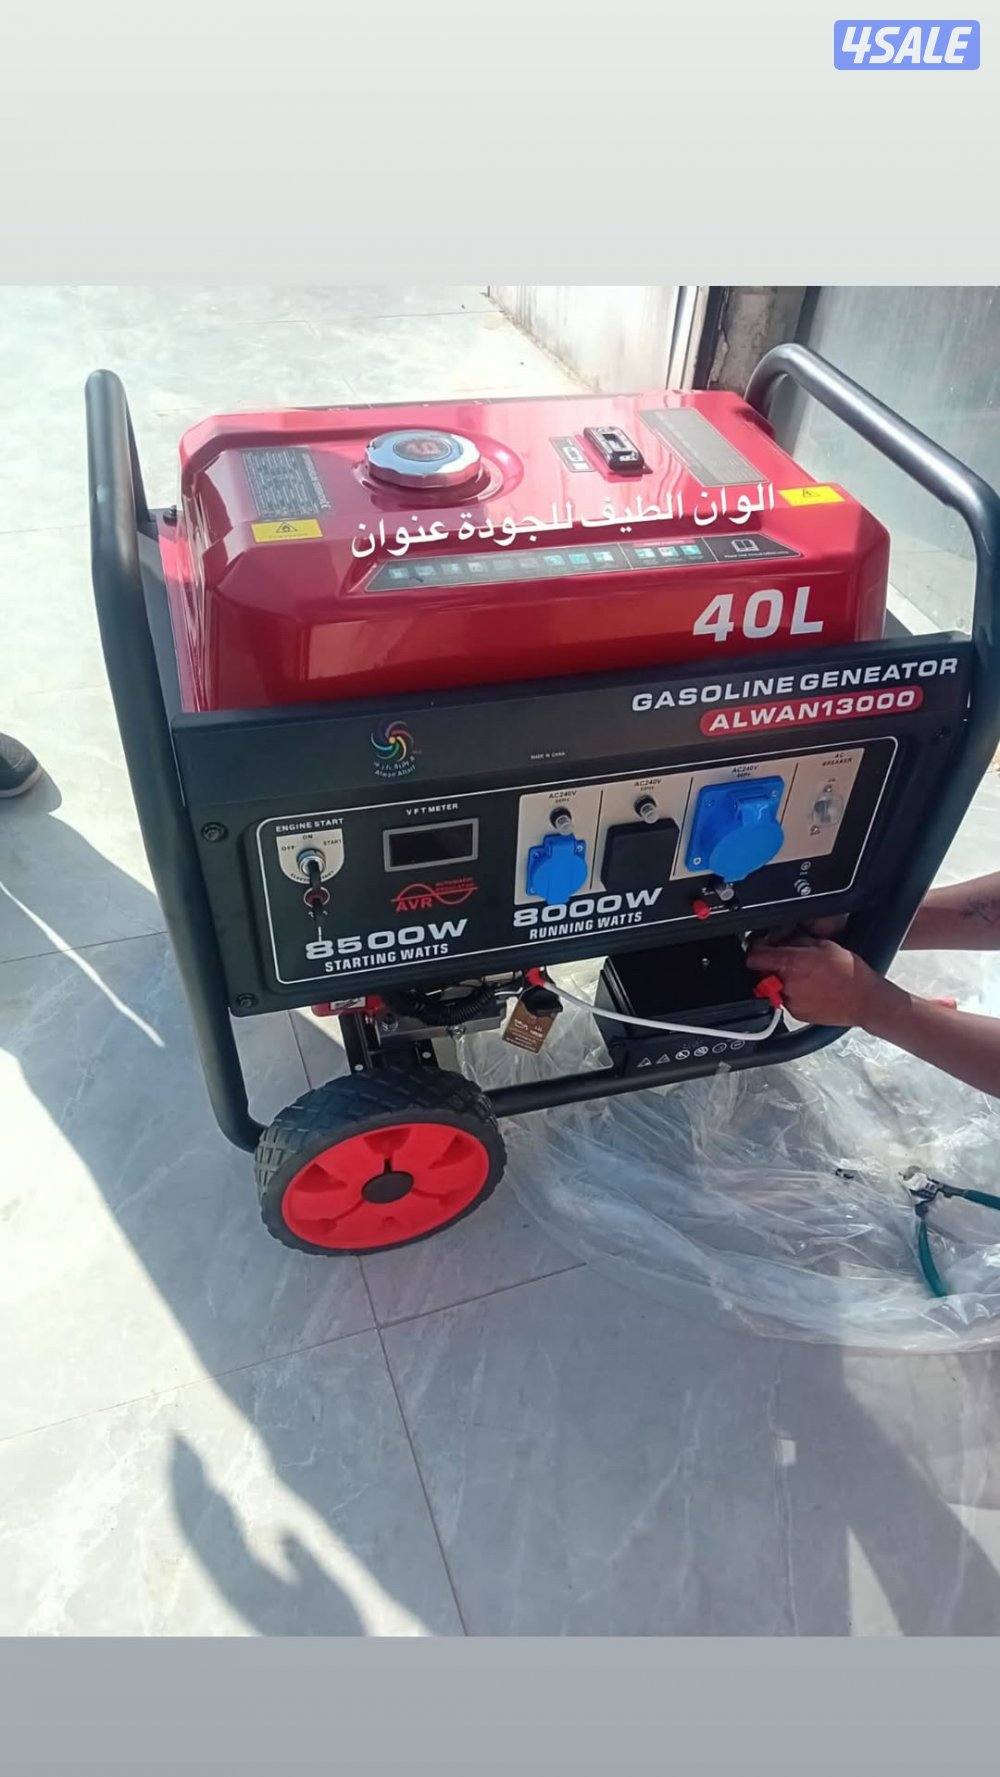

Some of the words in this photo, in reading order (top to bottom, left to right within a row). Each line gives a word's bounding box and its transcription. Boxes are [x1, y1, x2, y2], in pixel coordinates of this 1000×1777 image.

[692, 585, 824, 642] 40L
[631, 676, 795, 712] GASOLINE
[799, 657, 959, 692] GENEATOR
[707, 689, 916, 732] ALWAN13000
[548, 790, 577, 799] AC240V
[275, 821, 313, 833] ENGINE
[314, 818, 344, 828] START
[396, 896, 433, 912] AVR
[512, 887, 664, 928] 8000W
[305, 918, 468, 960] 8500W
[528, 919, 594, 940] RUNNING
[597, 911, 643, 931] WATTS
[324, 950, 396, 973] STARTING
[400, 943, 449, 961] WATTS
